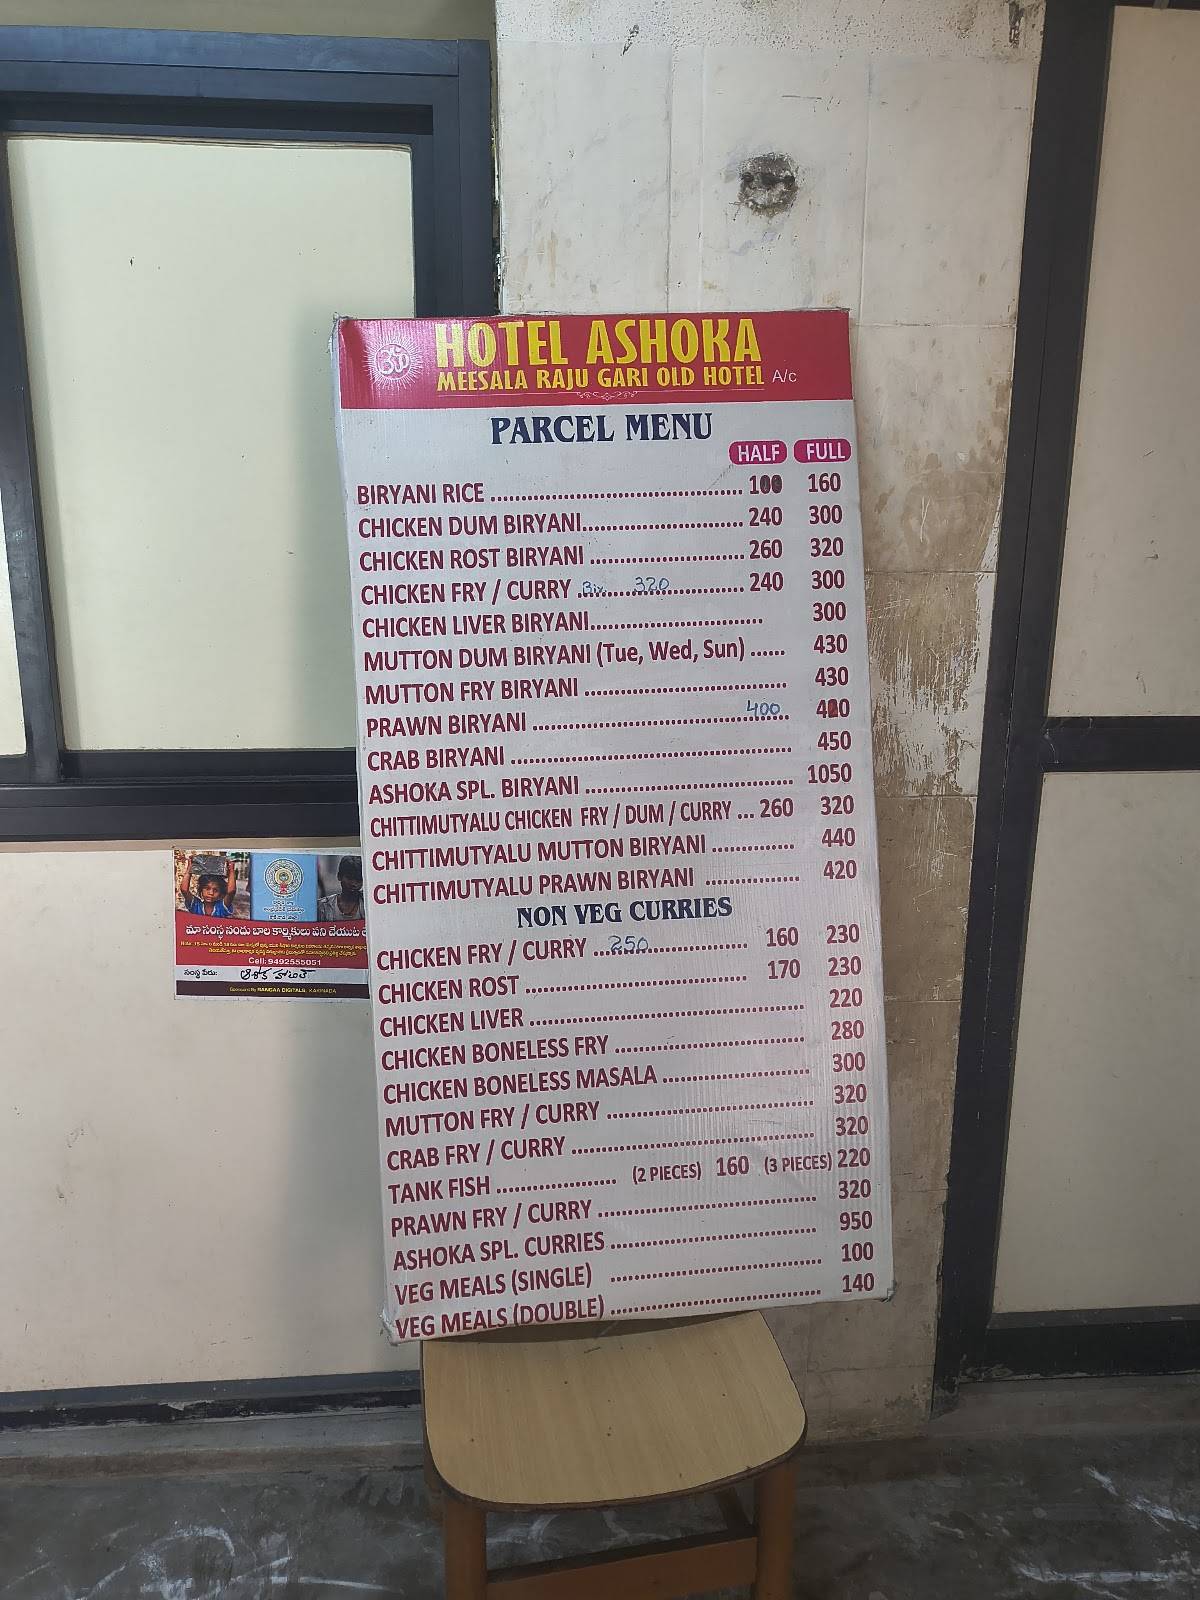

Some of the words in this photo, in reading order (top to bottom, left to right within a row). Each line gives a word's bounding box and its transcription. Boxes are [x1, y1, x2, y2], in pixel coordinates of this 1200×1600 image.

[436, 319, 568, 369] HOTEL
[586, 319, 761, 364] ASHOKA
[437, 368, 528, 391] MEESALA
[537, 369, 588, 390] RAJU
[598, 368, 648, 387] GARI
[657, 367, 694, 386] OLD
[704, 366, 764, 385] HOTEL
[771, 369, 798, 384] A/c
[491, 415, 614, 444] PARCEL
[625, 413, 712, 440] MENU
[738, 444, 779, 461] HALF
[807, 443, 845, 460] FULL
[358, 484, 436, 504] BIRYANI
[443, 483, 484, 503] RICE
[750, 475, 782, 494] 100
[808, 473, 841, 492] 160
[359, 517, 442, 538] CHICKEN
[449, 516, 497, 535] DUM
[504, 513, 580, 534] BIRYANI
[749, 507, 782, 526] 240
[809, 505, 842, 524] 300
[360, 550, 443, 571] CHICKEN
[451, 549, 500, 569] ROST
[507, 546, 583, 567] BIRYANI
[750, 539, 782, 559] 260
[811, 537, 843, 557] 320
[362, 584, 445, 605] CHICKEN
[452, 582, 486, 602] FRY
[507, 579, 571, 600] CURRY
[750, 572, 783, 591] 240
[812, 570, 844, 589] 300
[634, 577, 670, 593] 320
[363, 616, 446, 638] CHICKEN
[453, 615, 506, 635] LIVER
[512, 611, 588, 632] BIRYANI
[813, 602, 846, 621] 300
[365, 649, 452, 671] MUTTON
[459, 648, 507, 668] DUM
[514, 644, 590, 665] BIRYANI
[597, 642, 643, 667] (Tue,
[649, 639, 698, 663] Wed,
[704, 637, 744, 661] Sun)
[814, 634, 847, 653] 430
[366, 683, 454, 704] MUTTON
[461, 681, 495, 701] FRY
[502, 678, 578, 699] BIRYANI
[815, 667, 848, 686] 430
[367, 716, 441, 737] PRAWN
[449, 712, 525, 734] BIRYANI
[816, 699, 849, 718] 40
[747, 700, 781, 717] 400
[368, 750, 419, 771] CRAB
[426, 746, 504, 768] BIRYANI
[818, 731, 851, 750] 450
[369, 782, 452, 804] ASHOKA
[457, 780, 495, 800] SPL.
[502, 776, 578, 798] BIRYANI
[808, 763, 851, 783] 1050
[371, 812, 500, 837] CHITTIMUTYALU
[505, 808, 572, 830] CHICKEN
[581, 807, 608, 826] FRY
[626, 804, 663, 824] DUM
[681, 801, 731, 821] CURRY
[760, 798, 793, 818] 260
[821, 795, 854, 815] 320
[373, 843, 531, 871] CHITTIMUTYALU
[538, 838, 623, 861] MUTTON
[630, 835, 705, 856] BIRYANI
[822, 828, 855, 847] 440
[374, 876, 532, 904] CHITTIMUTYALU
[539, 872, 611, 894] PRAWN
[618, 868, 693, 889] BIRYANI
[824, 860, 857, 879] 420
[517, 906, 567, 928] NON
[574, 903, 622, 924] VEG
[630, 897, 732, 921] CURRIES
[377, 946, 461, 970] CHICKEN
[468, 943, 502, 964] FRY
[523, 938, 586, 960] CURRY
[766, 927, 798, 947] 160
[827, 924, 859, 944] 230
[608, 935, 648, 952] 250
[379, 979, 462, 1004] CHICKEN
[469, 975, 519, 997] ROST
[768, 959, 800, 979] 170
[828, 956, 861, 976] 230
[380, 1012, 464, 1037] CHICKEN
[471, 1008, 523, 1030] LIVER
[830, 988, 862, 1008] 220
[382, 1045, 465, 1070] CHICKEN
[472, 1038, 569, 1063] BONELESS
[575, 1035, 608, 1056] FRY
[831, 1020, 864, 1040] 280
[384, 1078, 467, 1104] CHICKEN
[474, 1071, 570, 1096] BONELESS
[577, 1065, 657, 1088] MASALA
[833, 1052, 865, 1072] 300
[386, 1111, 474, 1137] MUTTON
[481, 1107, 514, 1128] FRY
[536, 1101, 599, 1124] CURRY
[834, 1084, 866, 1104] 320
[387, 1147, 439, 1170] CRAB
[446, 1143, 480, 1165] FRY
[501, 1136, 565, 1160] CURRY
[836, 1116, 868, 1136] 320
[388, 1180, 443, 1204] TANK
[449, 1176, 489, 1198] FISH
[633, 1166, 646, 1185] (2
[650, 1162, 701, 1181] PIECES)
[717, 1156, 749, 1176] 160
[765, 1157, 777, 1175] (3
[782, 1152, 832, 1172] PIECES)
[838, 1148, 870, 1168] 220
[392, 1211, 466, 1237] PRAWN
[473, 1207, 507, 1228] FRY
[528, 1200, 591, 1223] CURRY
[839, 1179, 871, 1199] 320
[393, 1244, 475, 1270] ASHOKA
[480, 1240, 518, 1261] SPL.
[525, 1232, 604, 1257] CURRIES
[840, 1211, 872, 1230] 950
[395, 1282, 433, 1305] VEG
[440, 1274, 506, 1299] MEALS
[512, 1262, 591, 1295] (SINGLE)
[842, 1242, 873, 1262] 100
[395, 1315, 434, 1339] VEG
[441, 1308, 508, 1334] MEALS
[513, 1296, 605, 1327] (DOUBLE)
[843, 1273, 874, 1292] 140
